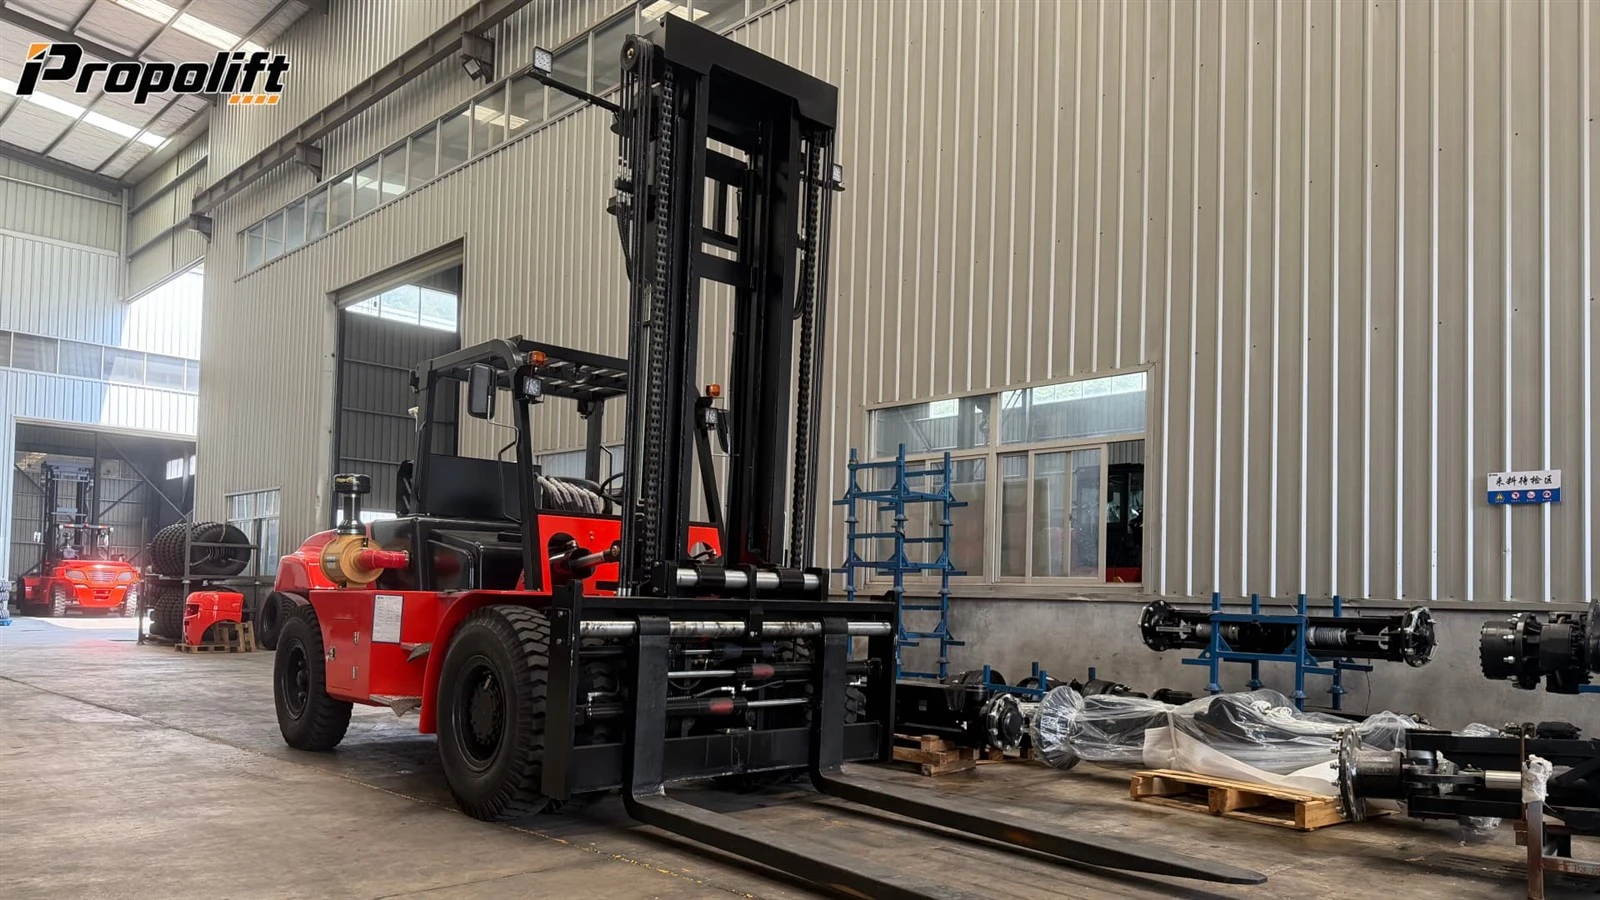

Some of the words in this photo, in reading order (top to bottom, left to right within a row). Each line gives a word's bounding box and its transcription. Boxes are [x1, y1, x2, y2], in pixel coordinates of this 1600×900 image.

[1496, 475, 1553, 487] 来料待检区
